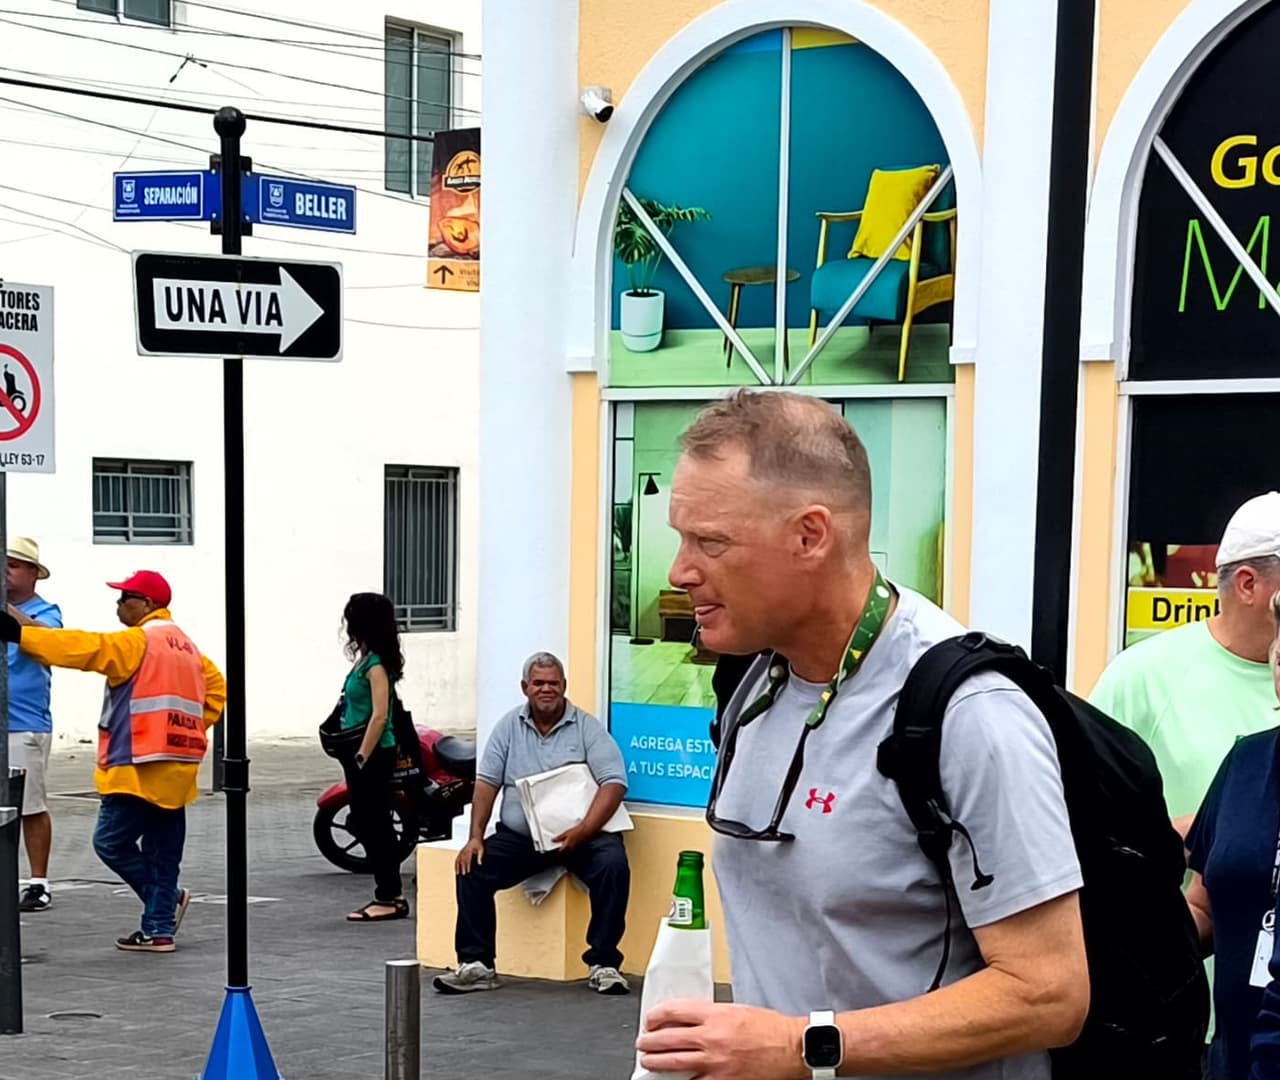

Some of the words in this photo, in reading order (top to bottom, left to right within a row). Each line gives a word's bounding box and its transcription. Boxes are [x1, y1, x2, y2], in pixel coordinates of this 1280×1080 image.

[144, 182, 198, 205] SEPARACIÓN
[295, 192, 347, 221] BELLER
[164, 286, 227, 324] UNA
[235, 289, 284, 327] VIA
[4, 452, 19, 465] LEY
[630, 736, 683, 752] AGREGA
[628, 761, 637, 774] A
[640, 762, 665, 776] TUS
